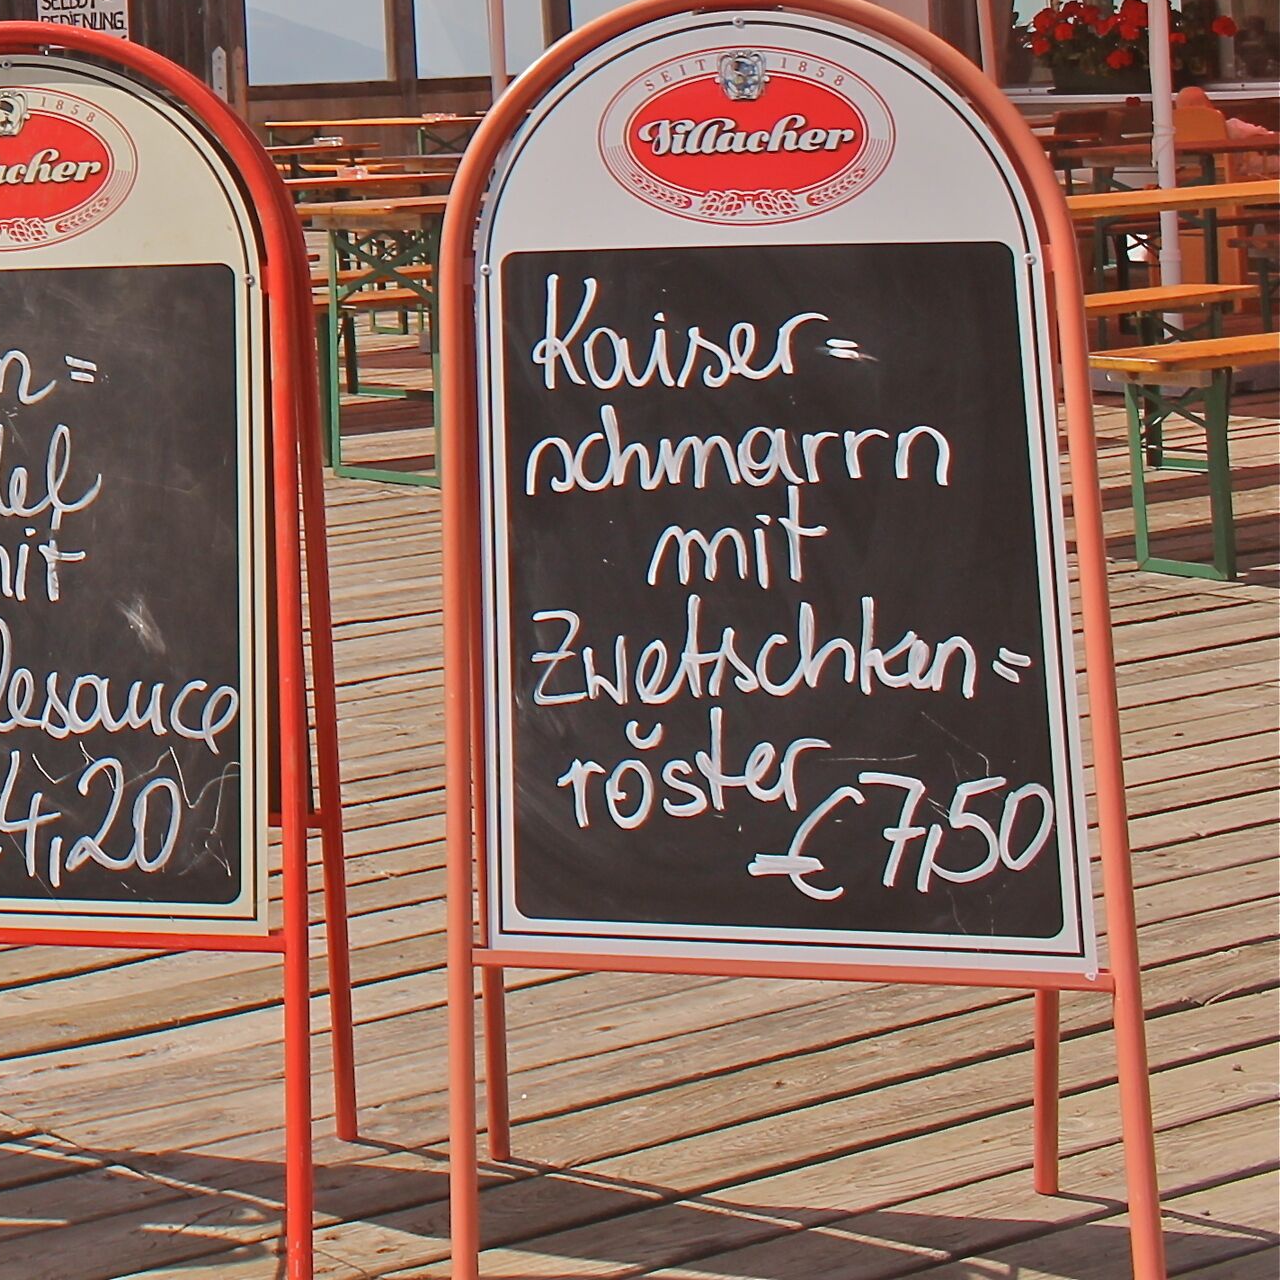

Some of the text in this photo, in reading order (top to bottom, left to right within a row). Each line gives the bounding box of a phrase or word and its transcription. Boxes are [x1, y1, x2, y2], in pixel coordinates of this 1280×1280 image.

[644, 56, 845, 91] SEIT 1858
[42, 95, 95, 122] 1858
[638, 114, 855, 155] Villacher
[526, 404, 951, 497] schmarrn
[647, 486, 829, 590] mit
